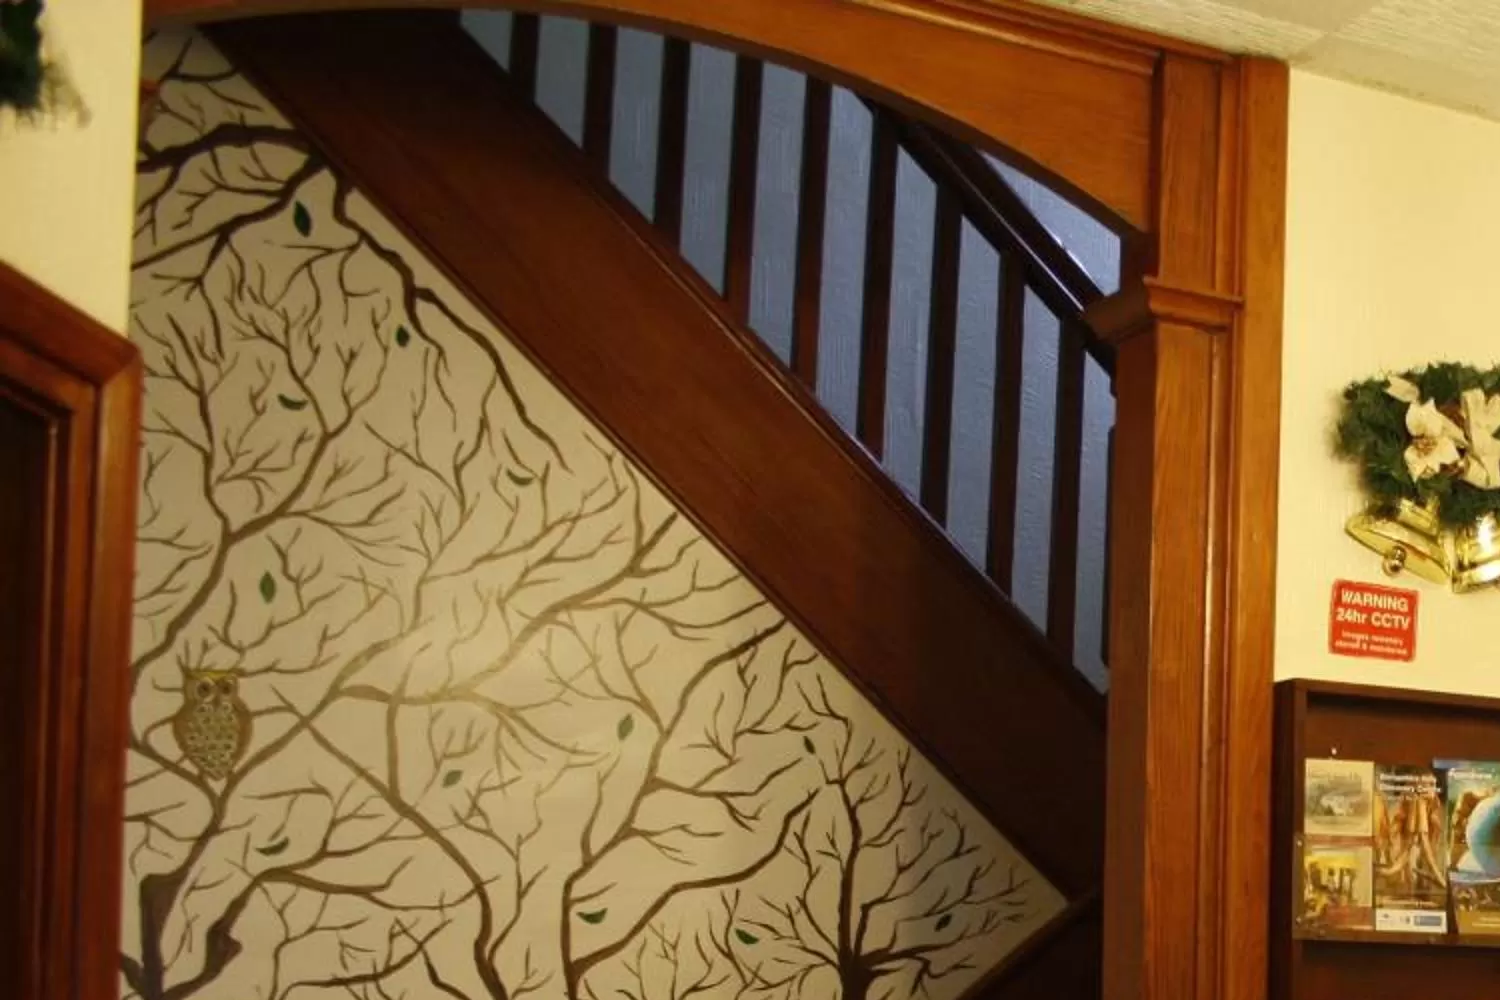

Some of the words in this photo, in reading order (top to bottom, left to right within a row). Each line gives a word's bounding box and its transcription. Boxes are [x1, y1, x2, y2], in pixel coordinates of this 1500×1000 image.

[1341, 588, 1409, 613] WARNING
[1336, 607, 1368, 625] 24hr
[1371, 612, 1411, 630] CCTV
